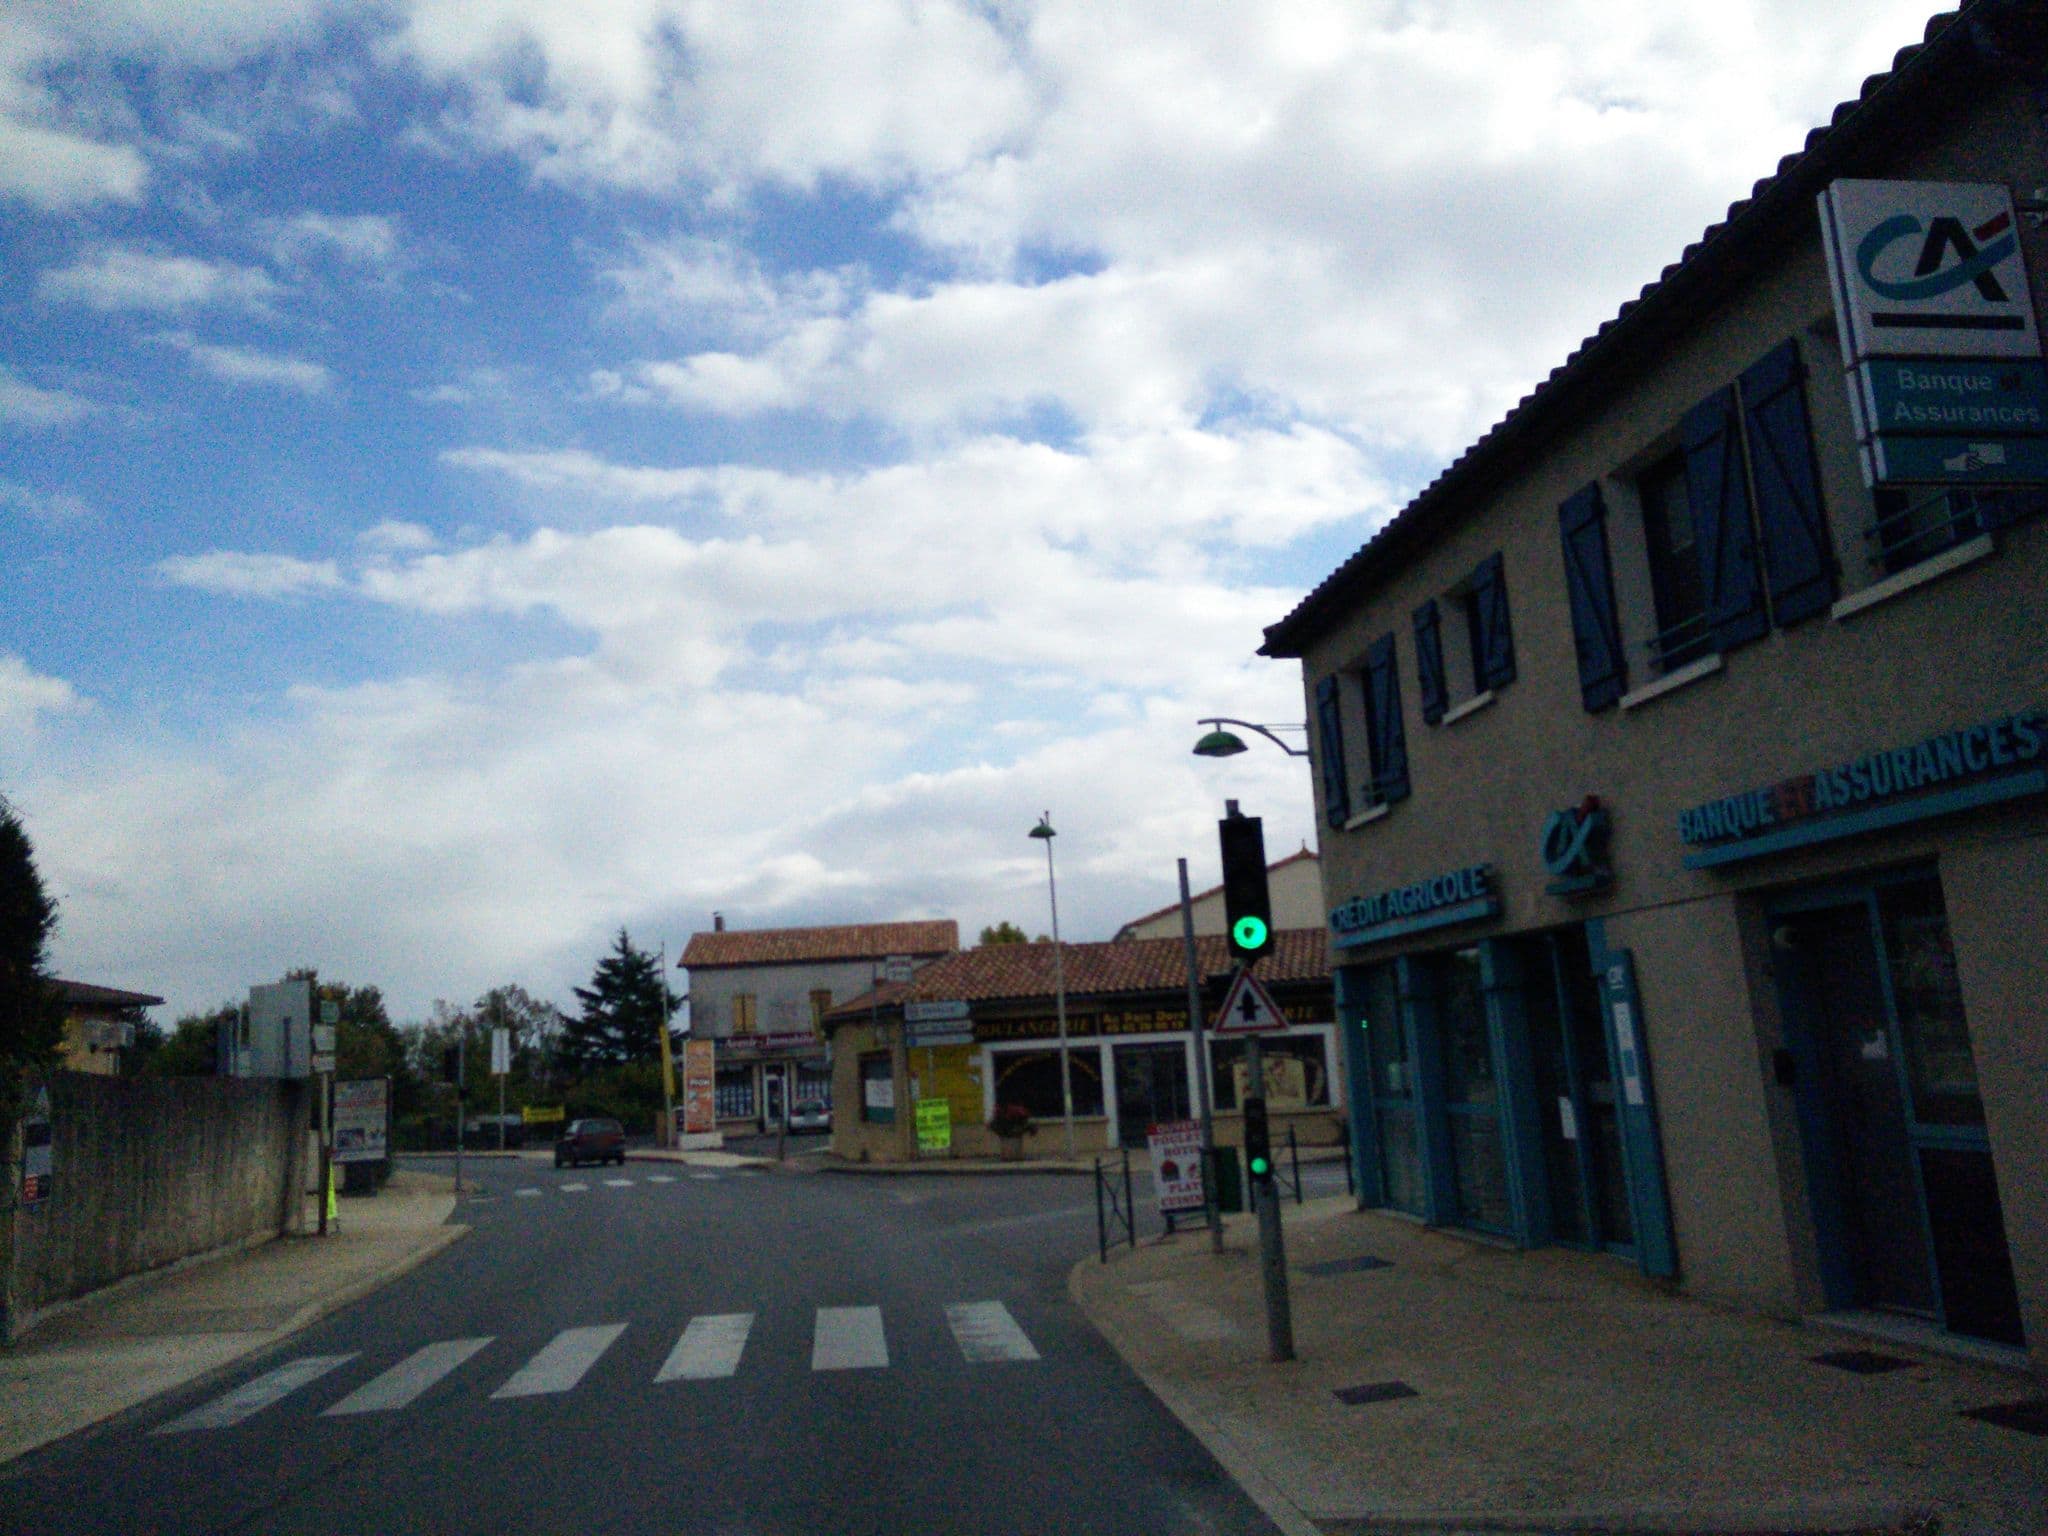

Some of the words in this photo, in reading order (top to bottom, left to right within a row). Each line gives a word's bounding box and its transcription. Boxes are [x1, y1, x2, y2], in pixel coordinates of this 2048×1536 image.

[1897, 368, 1993, 394] Banque
[1893, 401, 2042, 423] Assurances
[1678, 783, 1776, 845] BANQUE
[1777, 774, 1817, 821] ET
[1812, 711, 2046, 810] ASSURANCES
[1387, 864, 1489, 918] AGRICOLE
